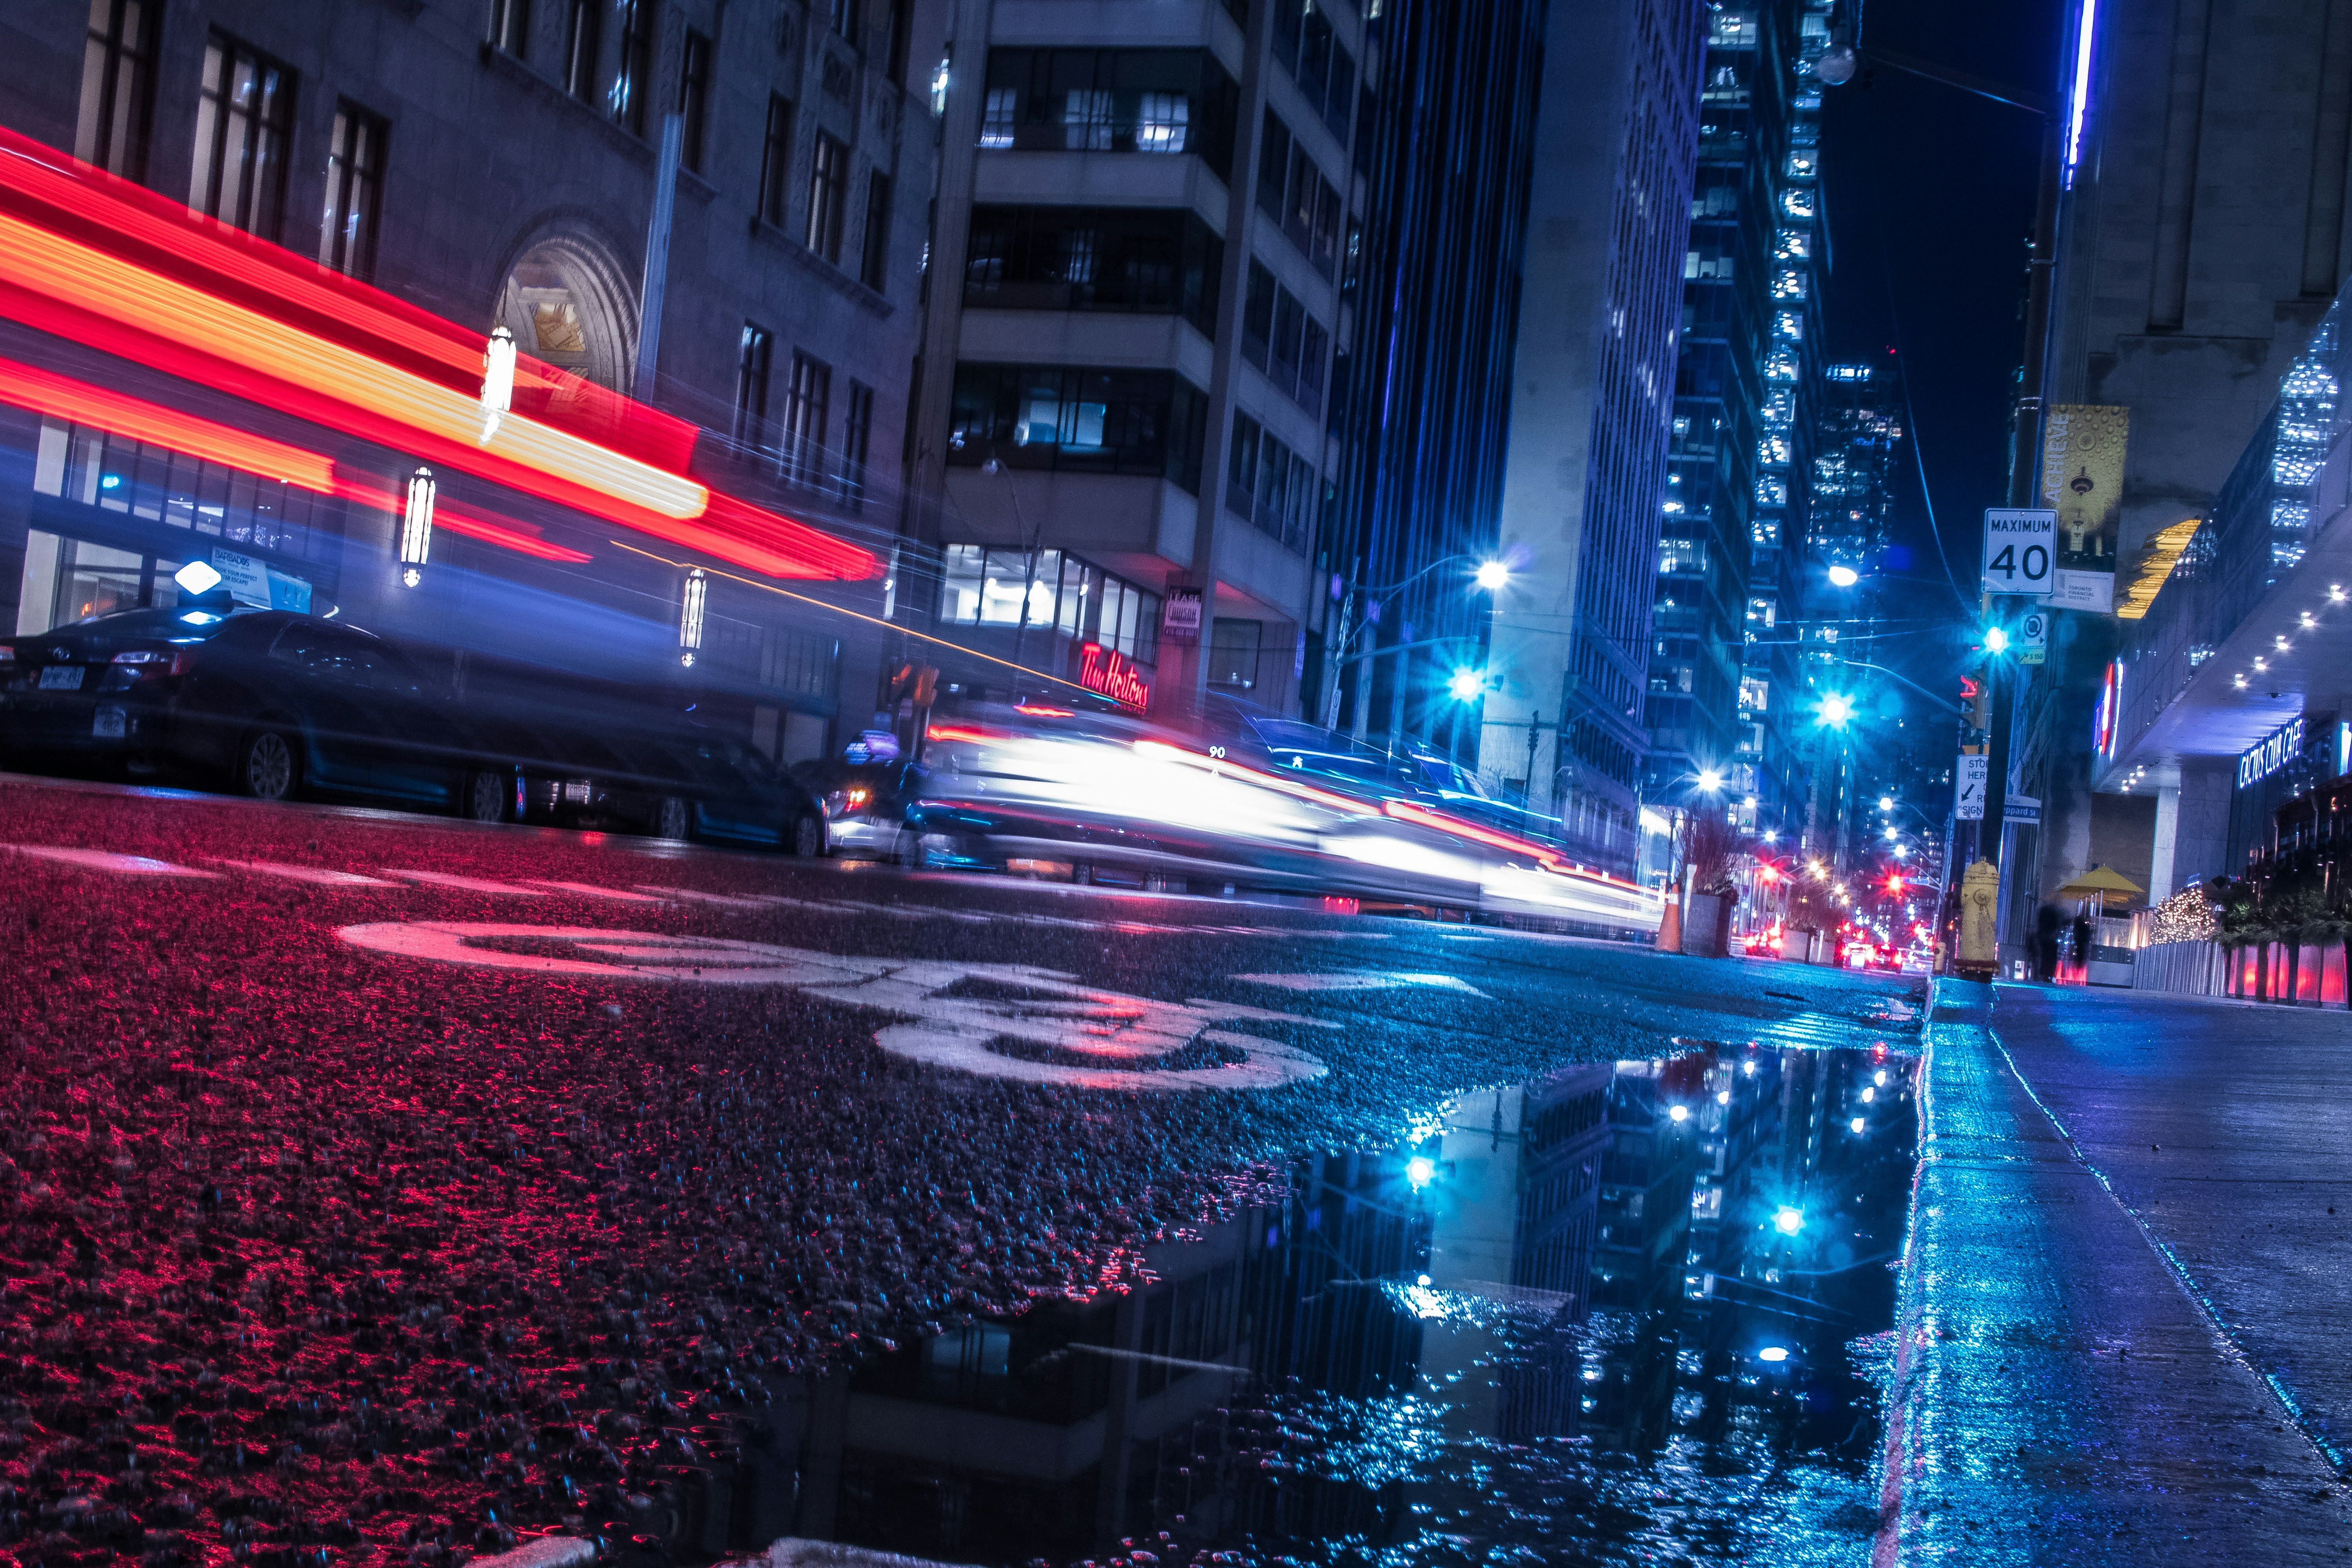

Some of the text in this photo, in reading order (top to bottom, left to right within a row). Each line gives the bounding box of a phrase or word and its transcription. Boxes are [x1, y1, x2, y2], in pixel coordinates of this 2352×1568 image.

[2045, 414, 2069, 503] ACHIEVE
[1991, 520, 2051, 532] MAXIMUM
[215, 549, 250, 566] BARBADOS
[1989, 544, 2049, 581] 40
[240, 572, 258, 582] PERFECT
[1081, 643, 1149, 706] Tim Hortons
[1209, 746, 1225, 759] 90
[2239, 719, 2303, 788] CACTUS CLUB CAFE
